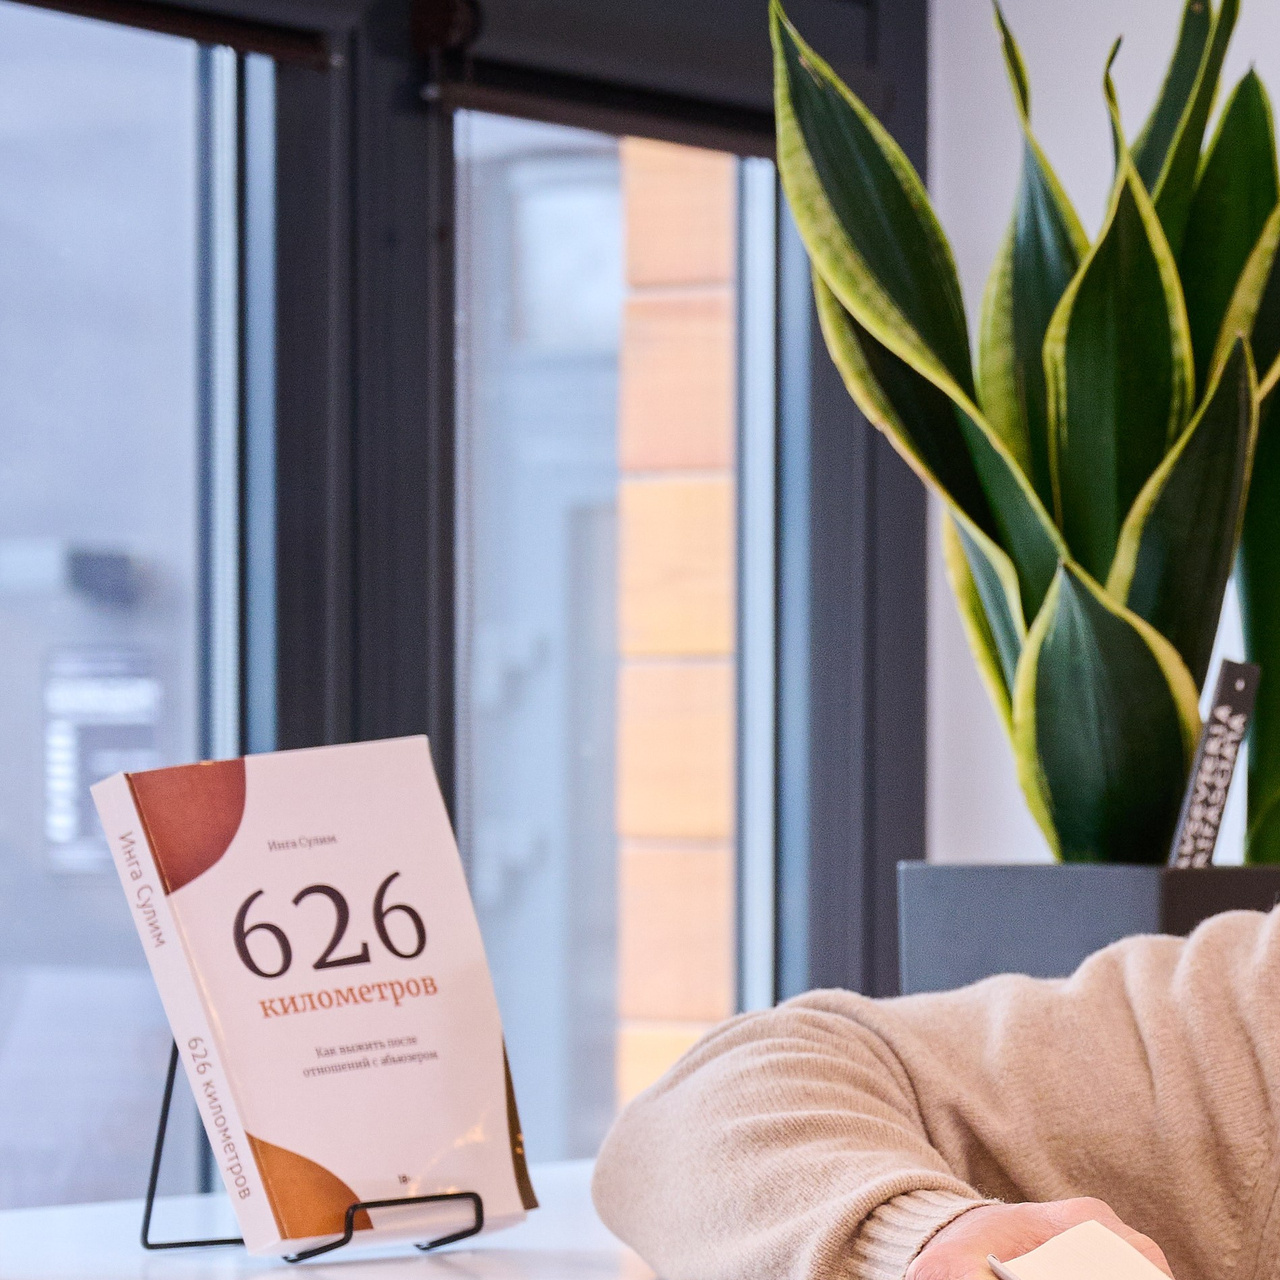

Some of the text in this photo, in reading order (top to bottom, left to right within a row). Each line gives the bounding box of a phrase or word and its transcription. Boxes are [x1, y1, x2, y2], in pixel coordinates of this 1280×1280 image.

[118, 831, 167, 948] Инга Сулим
[232, 871, 428, 979] 626
[259, 975, 439, 1020] километров
[187, 1036, 252, 1200] 626 километров
[303, 1057, 371, 1078] отношений
